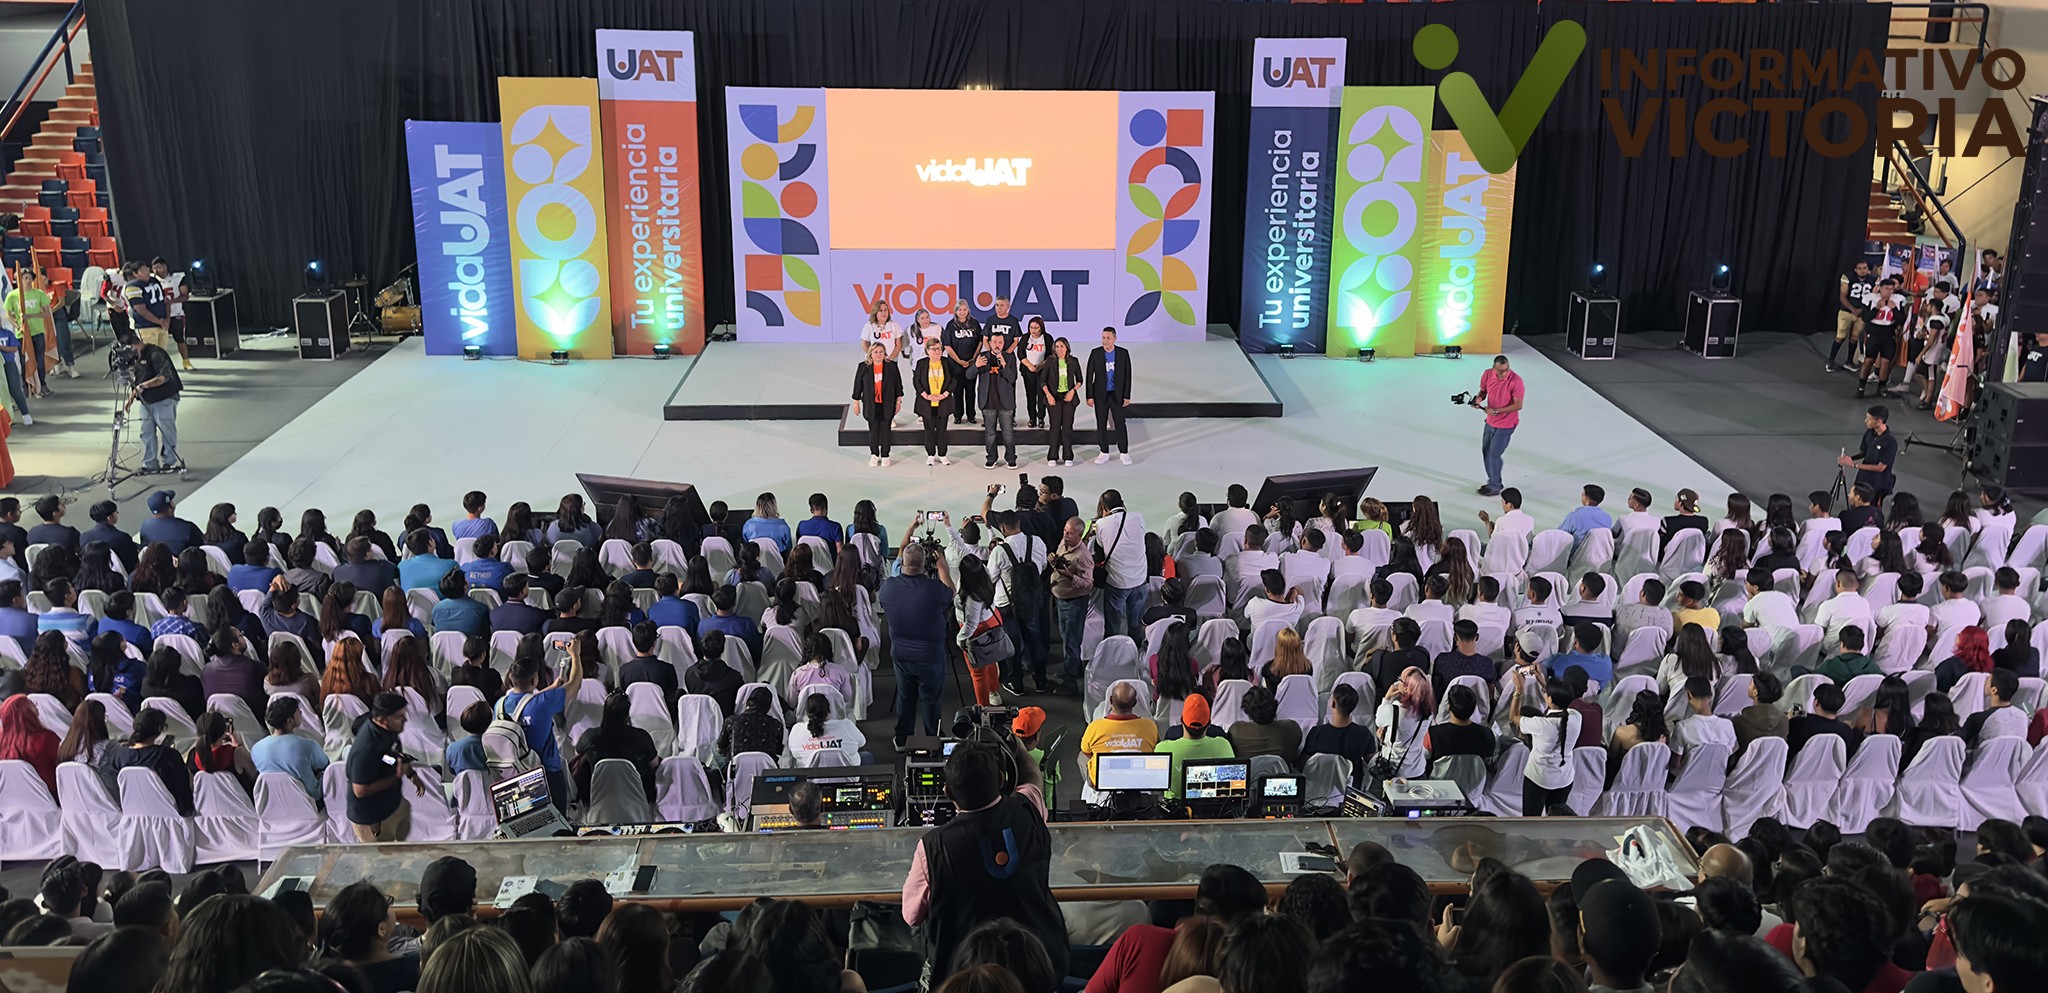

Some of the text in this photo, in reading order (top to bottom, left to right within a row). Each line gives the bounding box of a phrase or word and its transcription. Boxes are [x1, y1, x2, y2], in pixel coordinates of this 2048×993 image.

[606, 48, 683, 82] UAT
[1262, 56, 1336, 89] UAT
[915, 158, 1032, 187] vidaUAT
[622, 123, 657, 329] Tu experiencia
[653, 146, 685, 330] universitaria
[1258, 129, 1292, 330] Tu experiencia
[1288, 151, 1320, 330] universitaria
[434, 144, 490, 341] vidaUAT
[144, 283, 164, 304] 77
[852, 269, 1090, 323] vidaUAT
[1850, 283, 1872, 298] 26
[873, 331, 893, 341] UAT
[991, 324, 1011, 336] UAT
[1026, 342, 1044, 353] UAT
[802, 739, 843, 751] vidaUAT
[1104, 737, 1143, 748] vidaUAT
